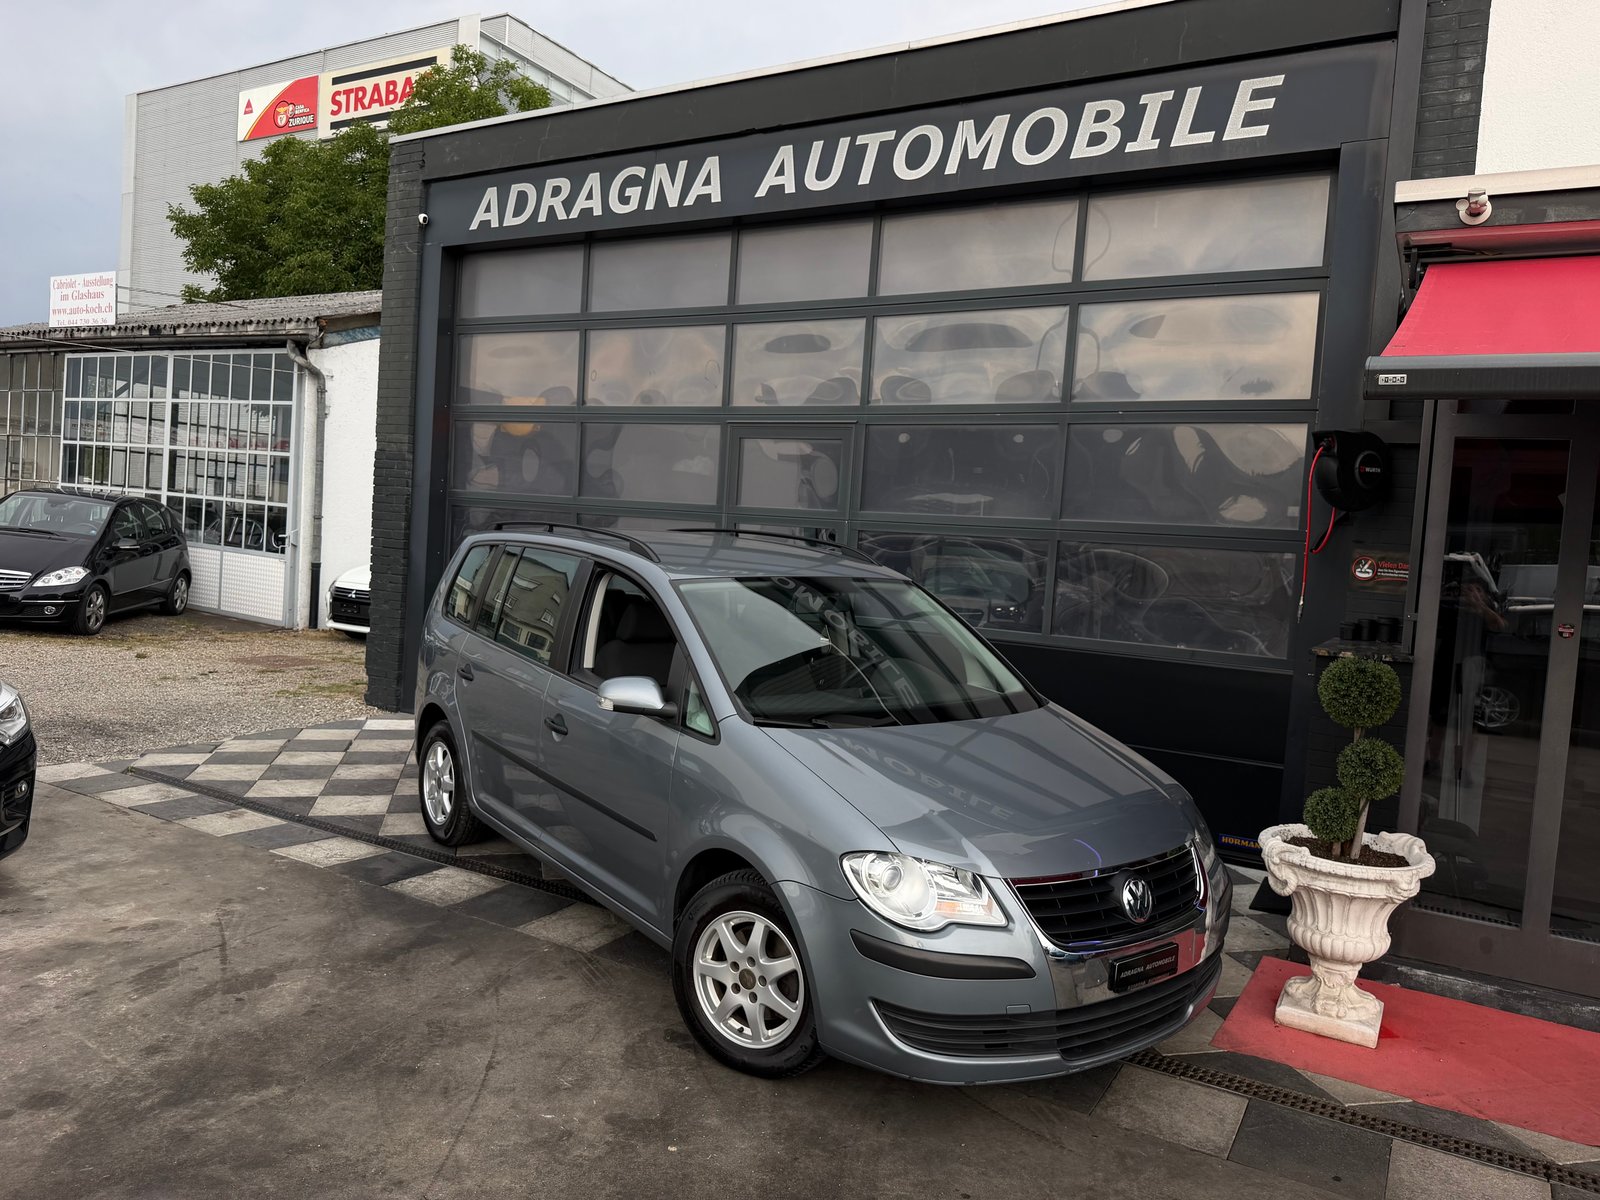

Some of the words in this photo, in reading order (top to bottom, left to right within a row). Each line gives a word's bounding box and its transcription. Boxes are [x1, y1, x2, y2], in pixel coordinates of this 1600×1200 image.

[330, 77, 413, 116] STRABA
[288, 115, 315, 127] ZURIQUE
[469, 155, 722, 231] ADRAGNA
[754, 74, 1286, 198] AUTOMOBILE
[83, 276, 113, 288] Ausstellung
[60, 292, 69, 301] im
[72, 289, 104, 301] Glashaus
[52, 302, 112, 315] www.auto-koch.ch
[1120, 966, 1144, 979] ADRAGNA
